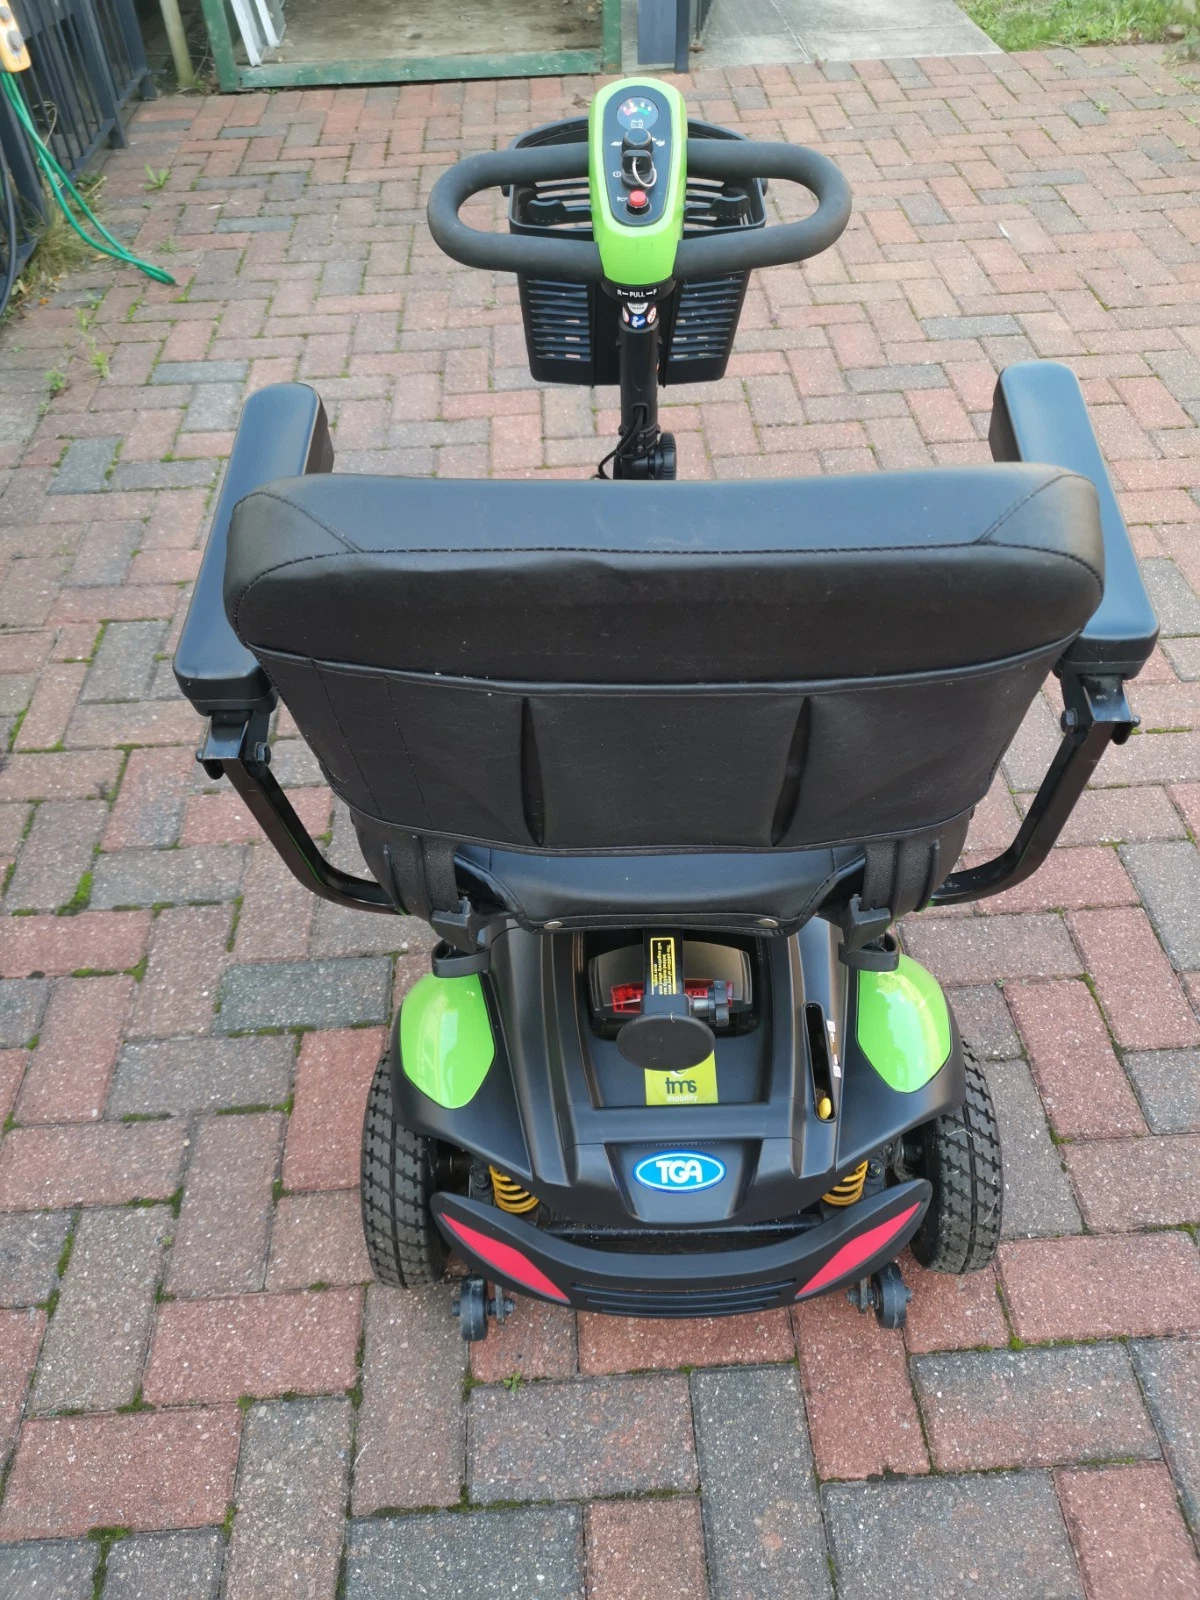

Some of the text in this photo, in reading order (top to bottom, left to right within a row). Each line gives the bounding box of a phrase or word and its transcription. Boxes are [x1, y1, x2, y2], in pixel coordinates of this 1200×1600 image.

[665, 1077, 697, 1094] tms
[666, 1095, 698, 1103] mobility
[655, 1159, 703, 1184] TGA
